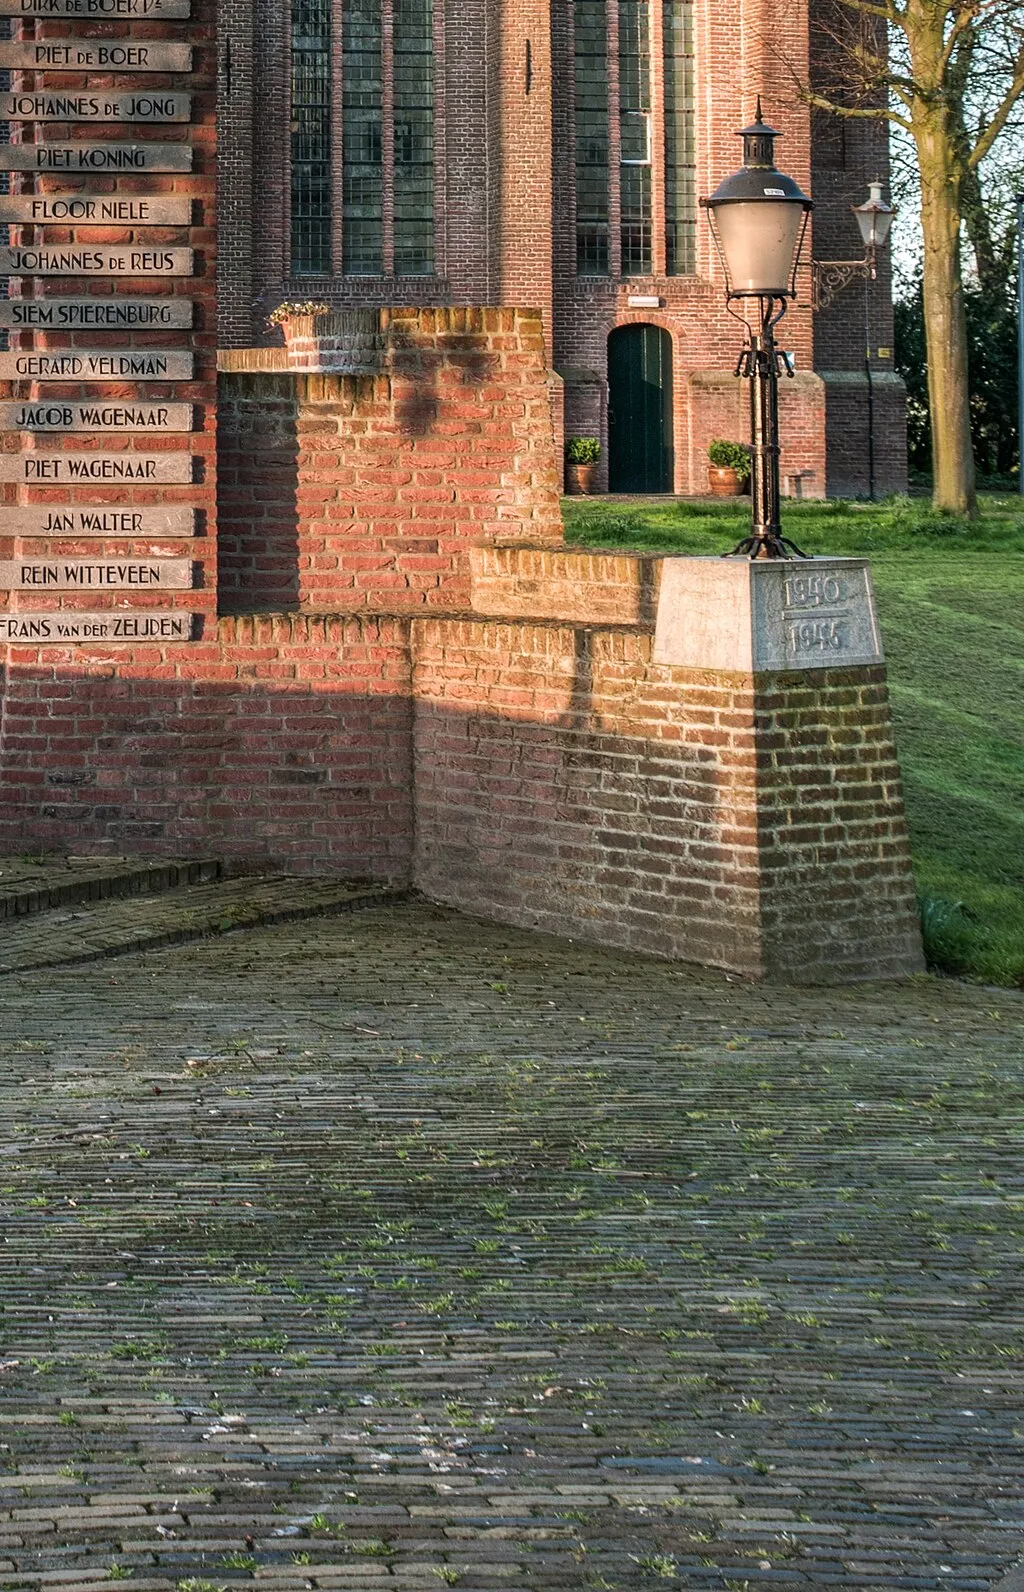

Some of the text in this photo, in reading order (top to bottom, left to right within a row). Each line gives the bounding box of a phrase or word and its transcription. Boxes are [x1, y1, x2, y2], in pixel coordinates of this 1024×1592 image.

[36, 46, 72, 65] PIET
[98, 47, 149, 66] BOER
[7, 97, 99, 116] JOHANNES
[126, 98, 175, 117] JONG
[37, 149, 145, 168] PIET KONING
[32, 201, 150, 220] FLOOR NIELE
[10, 252, 104, 270] JOHANNES
[131, 252, 175, 271] REUS
[12, 305, 171, 324] SIEM SPIERENBURG
[16, 357, 168, 376] GERARD VELDMAN
[15, 408, 168, 426] JACOB WAGENAAR
[25, 460, 156, 478] PIET WAGENAAR
[41, 513, 143, 531] JAN WALTER
[21, 565, 161, 584] REIN WITTEVEEN
[783, 576, 840, 606] 1940
[57, 625, 80, 637] VAN
[83, 624, 108, 637] DER
[112, 618, 183, 637] ZEIJDEN
[789, 621, 841, 652] 1945
